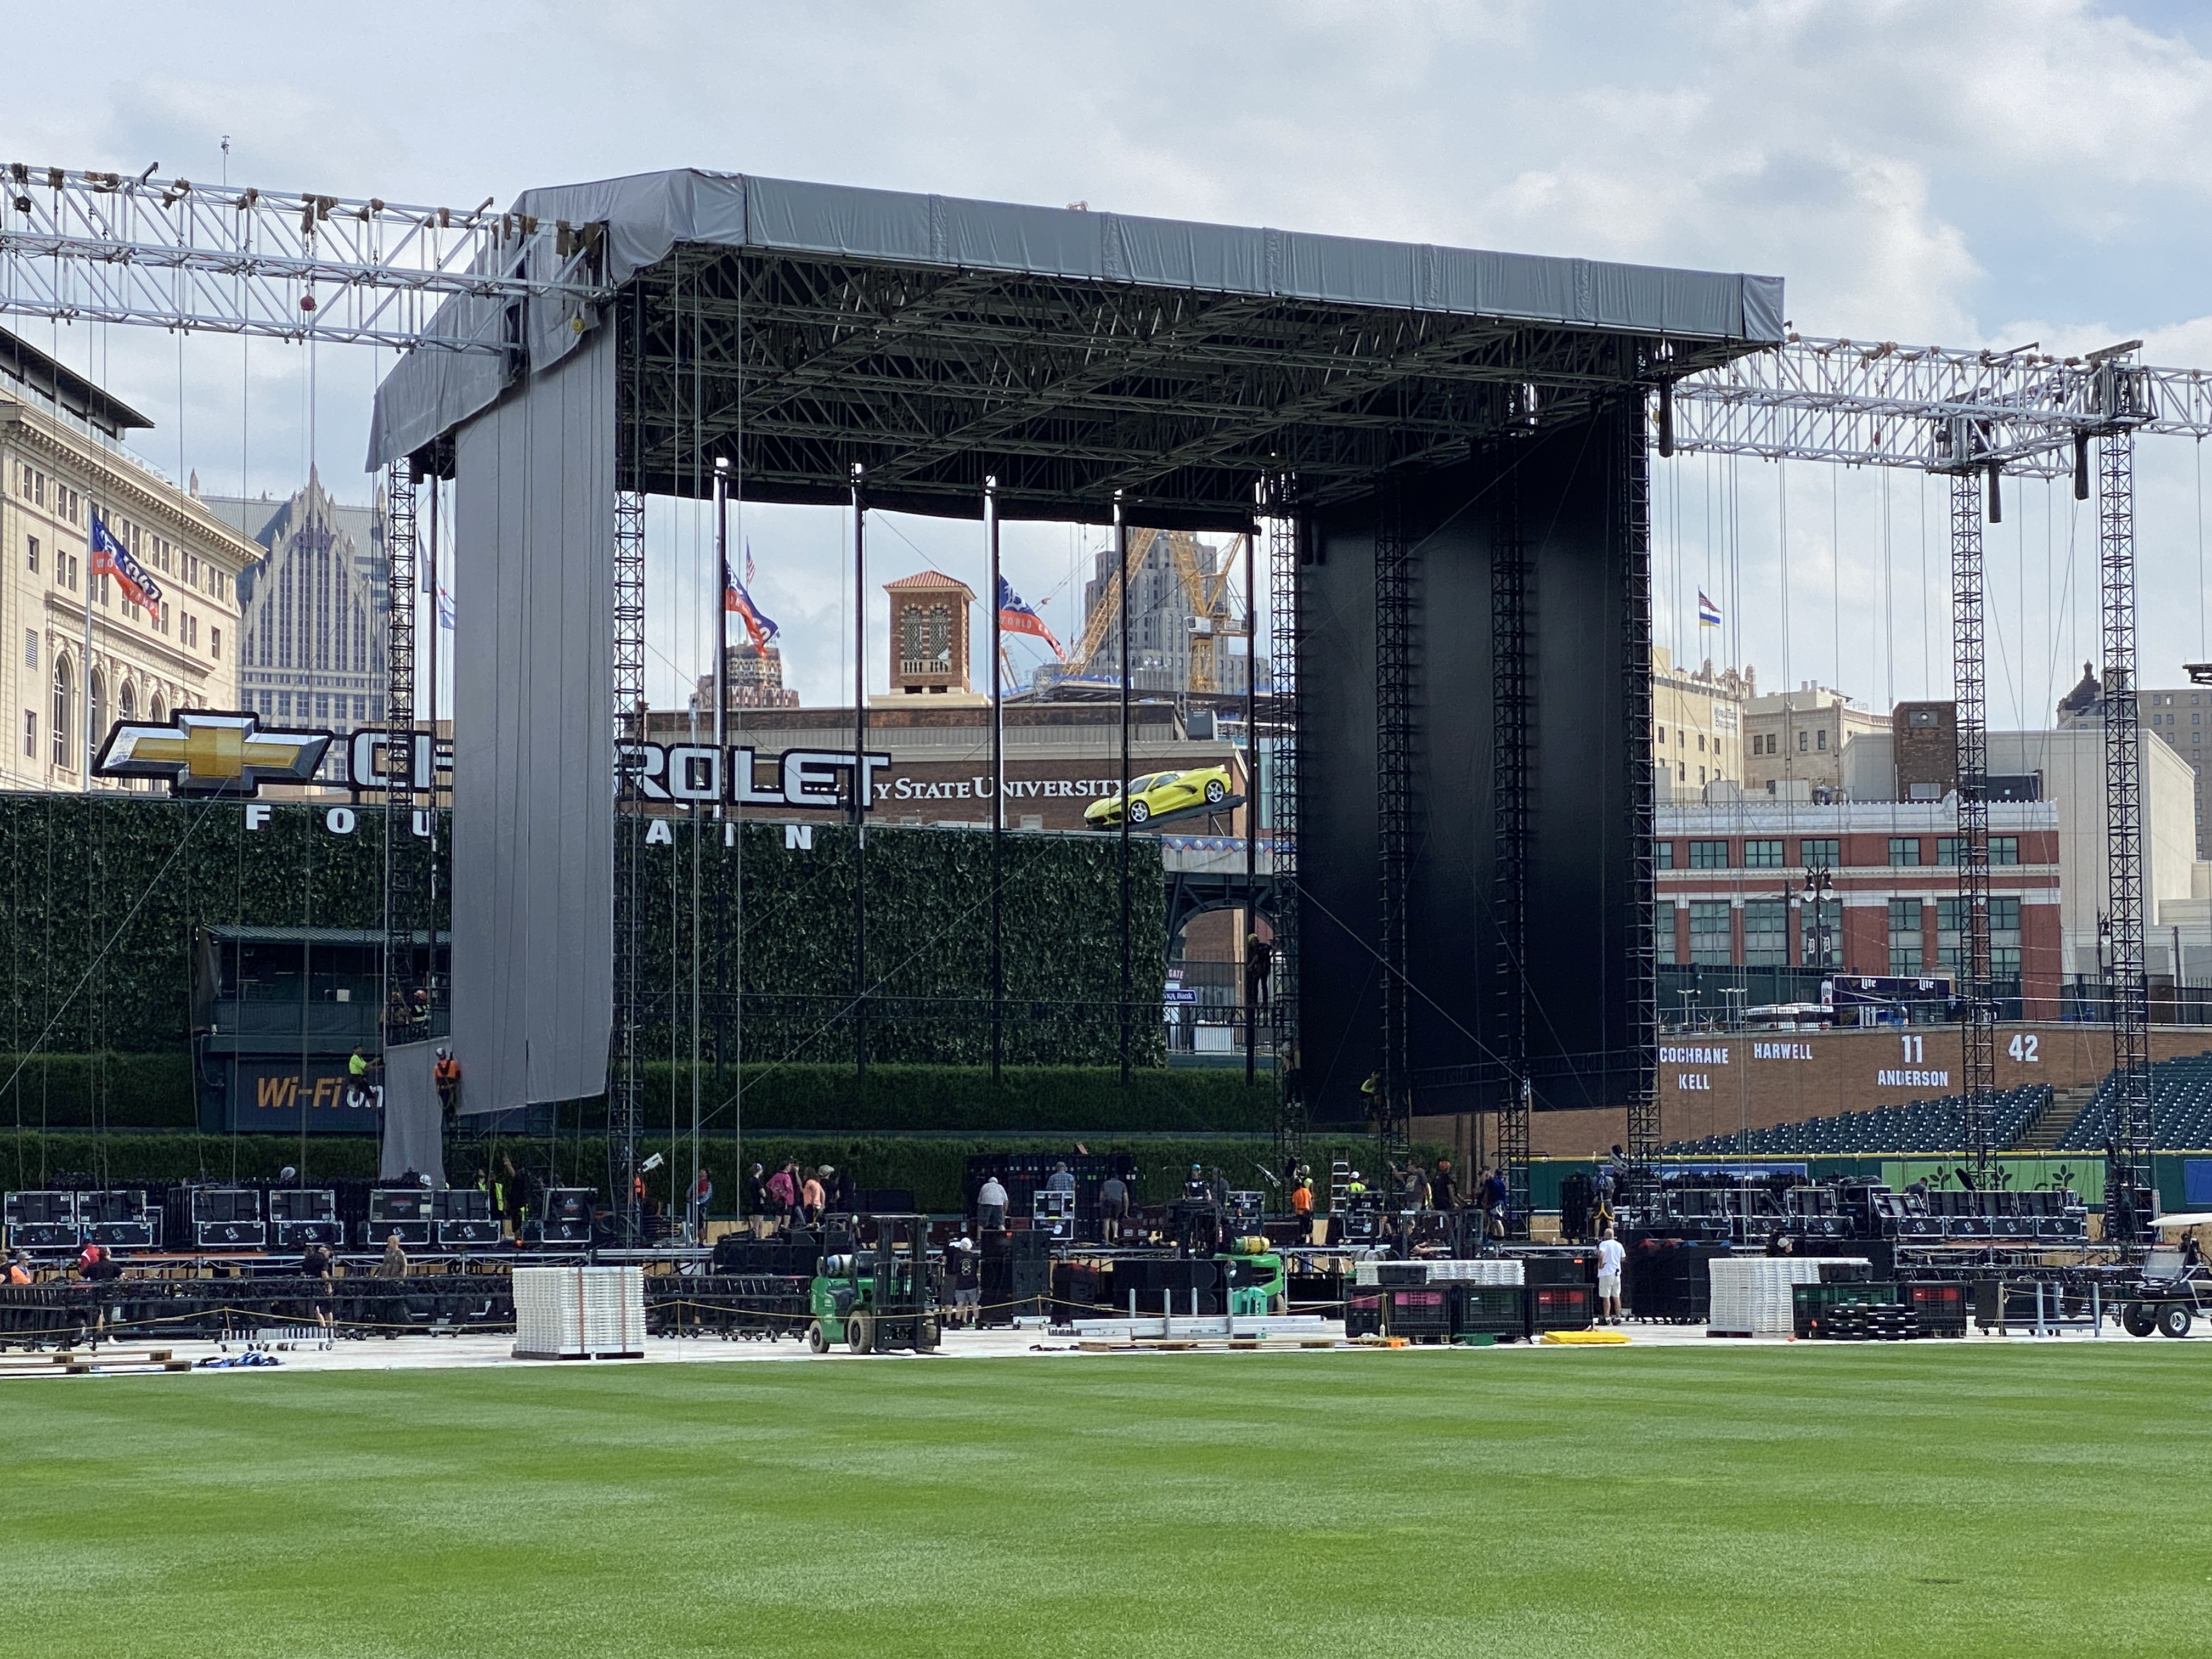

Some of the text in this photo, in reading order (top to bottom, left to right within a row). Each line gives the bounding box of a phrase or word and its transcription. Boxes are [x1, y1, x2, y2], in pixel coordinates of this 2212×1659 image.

[1169, 969, 1183, 979] GATE
[1861, 978, 1877, 990] Lite
[1919, 979, 1934, 991] Lite
[1660, 1047, 1728, 1064] COCHRANE
[1754, 1043, 1813, 1059] HARWELL
[1901, 1035, 1923, 1063] 11
[2008, 1034, 2039, 1062] 42
[1679, 1074, 1710, 1090] KELL
[1877, 1070, 1948, 1086] ANDERSON
[258, 1076, 342, 1107] Wi-Fi
